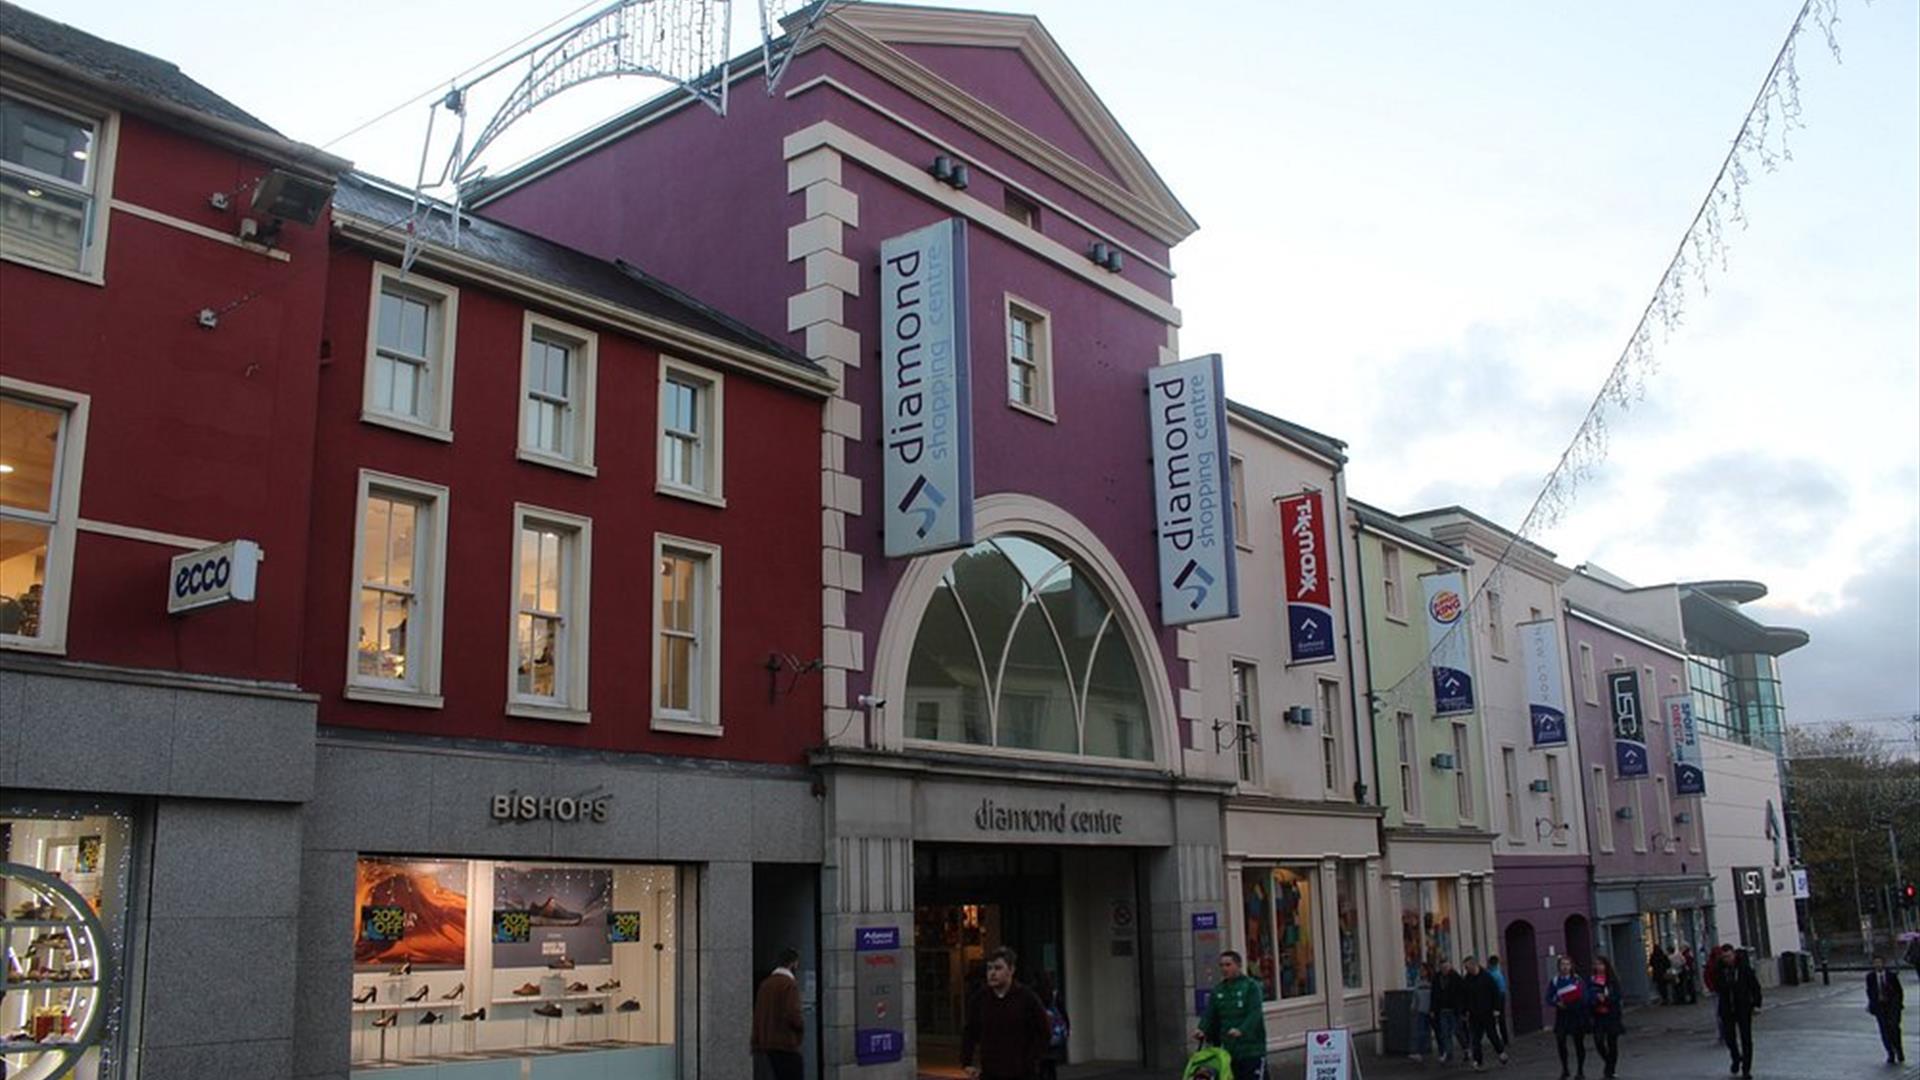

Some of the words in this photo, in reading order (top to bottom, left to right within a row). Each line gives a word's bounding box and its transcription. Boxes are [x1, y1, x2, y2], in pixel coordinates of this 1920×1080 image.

[927, 245, 944, 326] centre
[887, 250, 924, 464] diamond
[928, 339, 951, 460] shopping
[1190, 374, 1209, 441] centre
[1155, 377, 1194, 551] diamond
[1197, 451, 1217, 548] shopping
[175, 556, 230, 598] ecco
[1614, 675, 1637, 735] USC
[491, 794, 609, 822] BISHOPS
[975, 798, 1066, 833] diamond
[1070, 809, 1123, 834] centre
